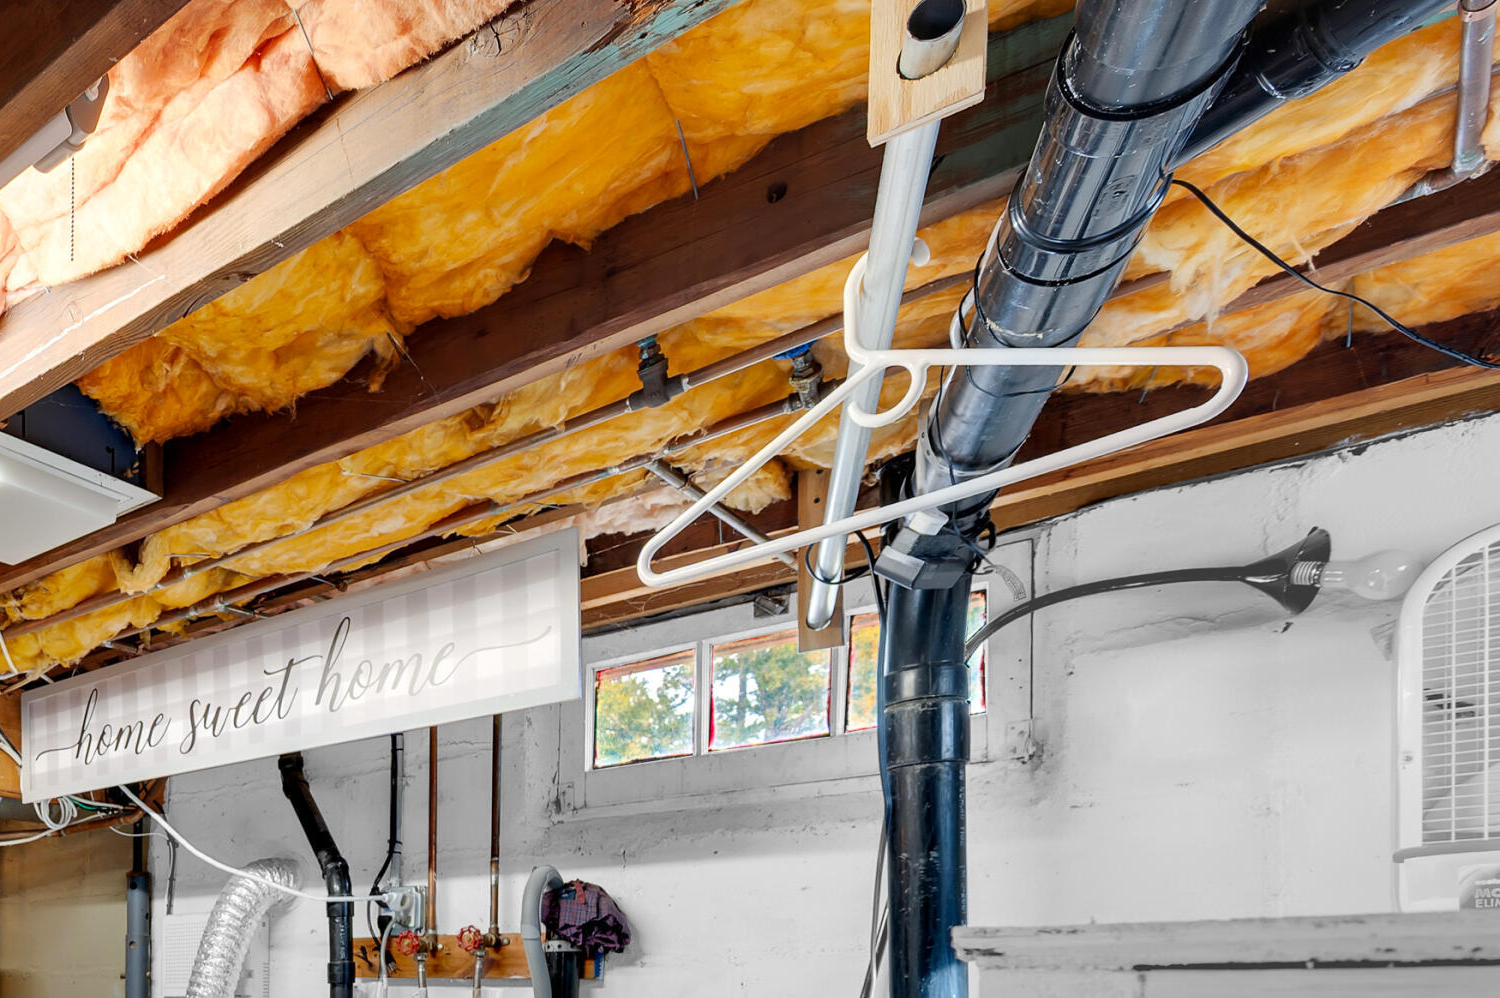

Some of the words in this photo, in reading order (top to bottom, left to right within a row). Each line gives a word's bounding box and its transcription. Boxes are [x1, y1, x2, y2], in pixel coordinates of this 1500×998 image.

[36, 688, 172, 765] home
[179, 655, 323, 755] sweet
[314, 616, 552, 713] home
